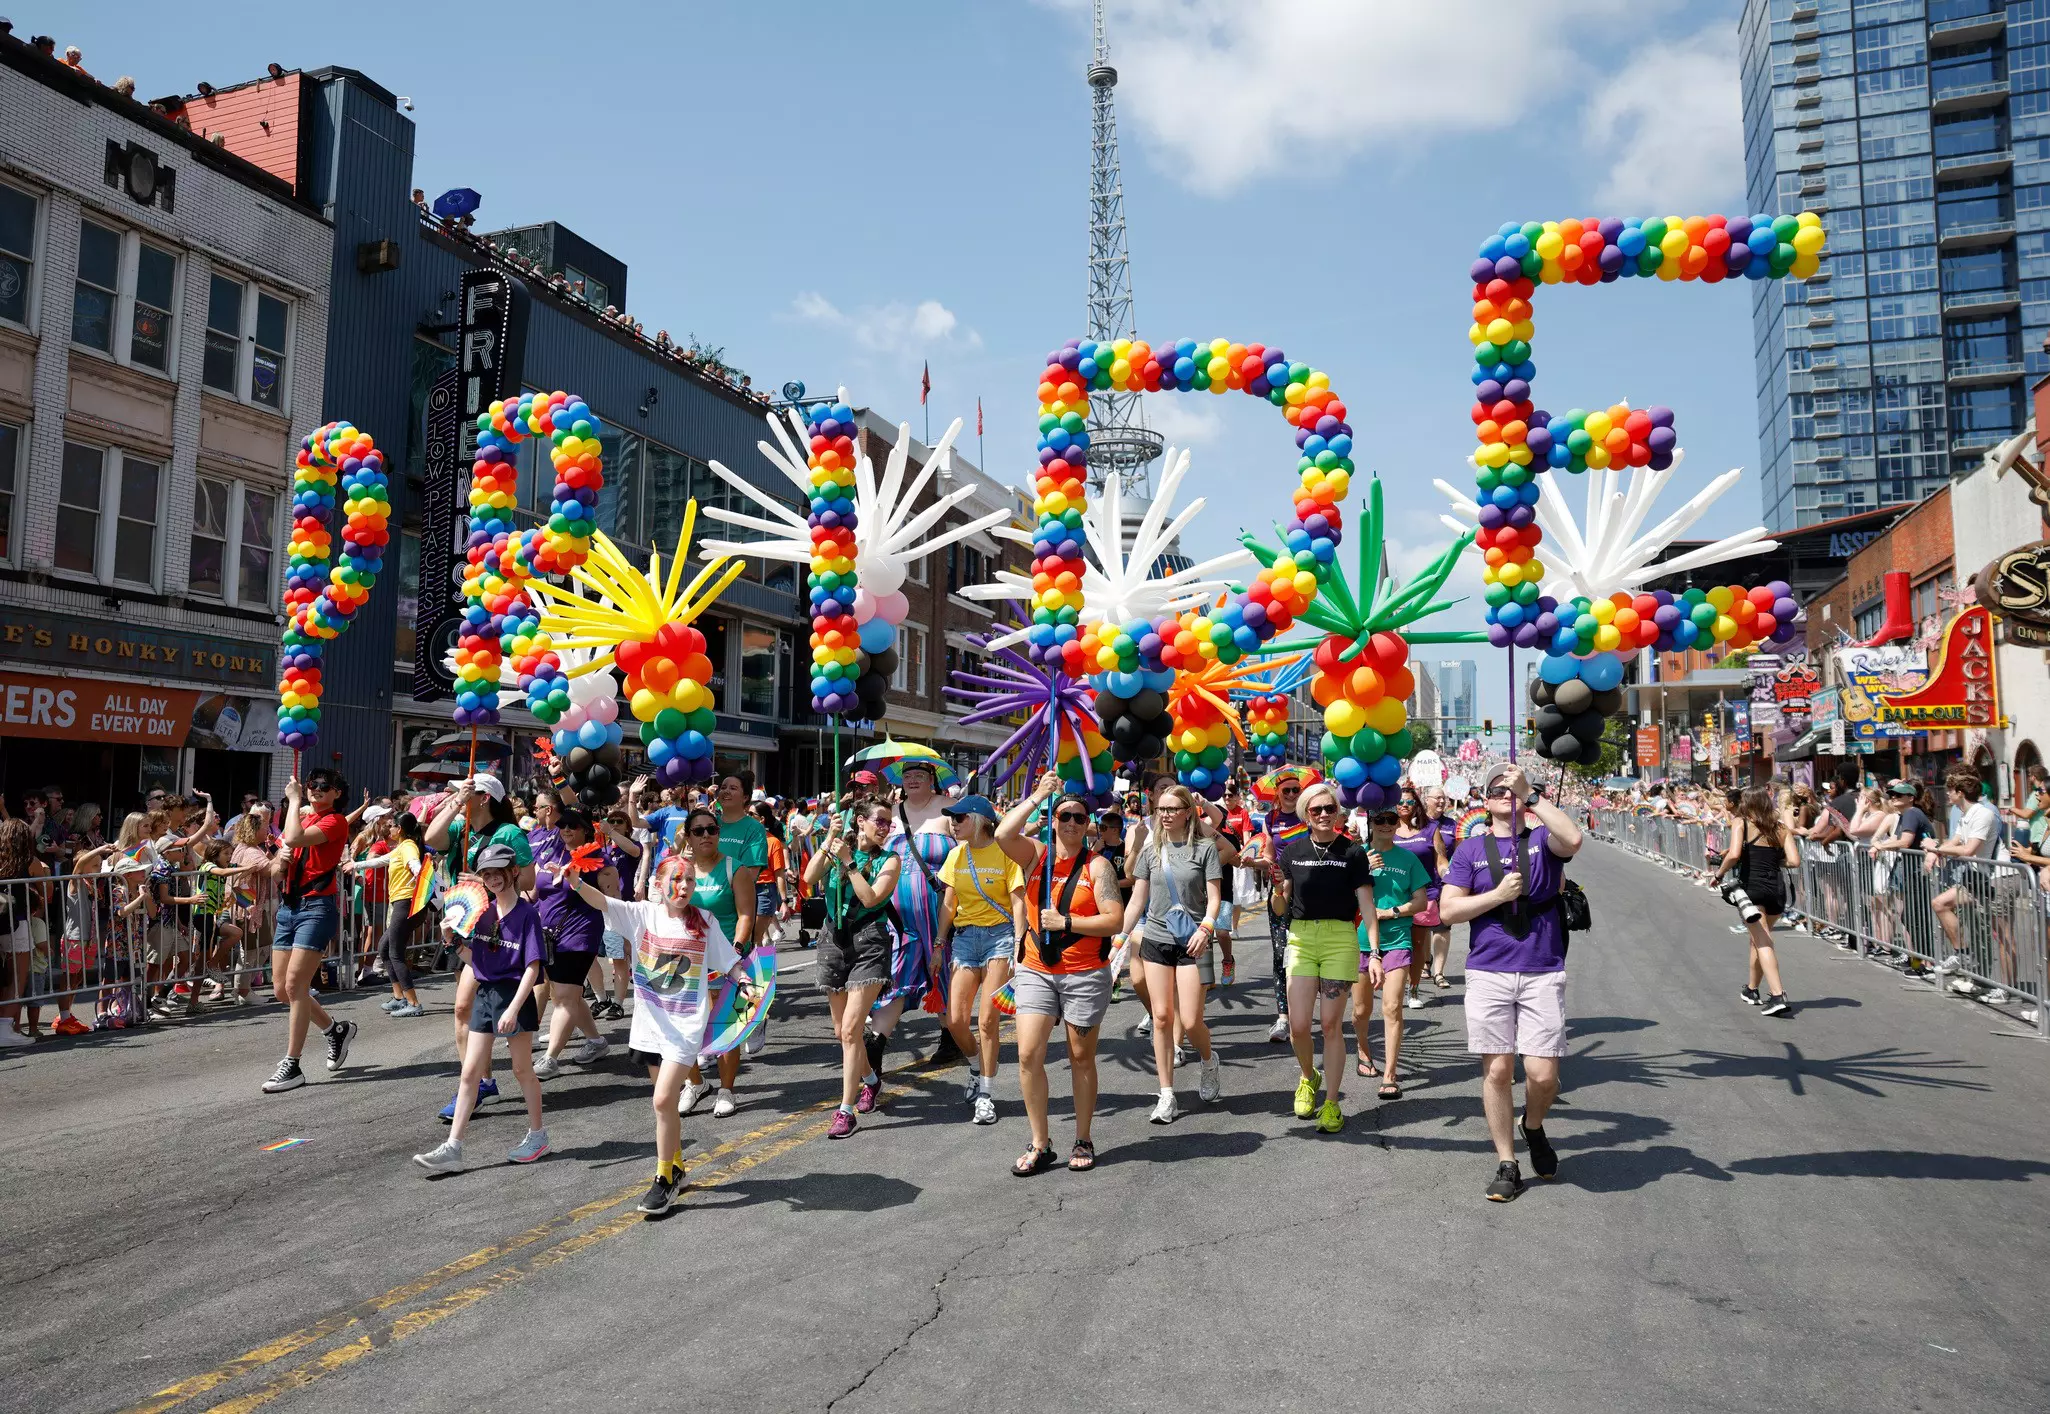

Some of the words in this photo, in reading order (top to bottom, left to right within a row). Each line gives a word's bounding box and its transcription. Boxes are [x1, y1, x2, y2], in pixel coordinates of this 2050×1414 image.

[435, 392, 445, 407] IN
[424, 490, 440, 610] PLACES
[1829, 531, 1880, 557] ASSE
[2018, 626, 2037, 641] ON
[68, 632, 179, 663] HONKY
[192, 650, 263, 673] TONK
[1960, 616, 1993, 724] JACKS
[0, 684, 77, 728] ERS
[104, 694, 135, 713] ALL
[139, 697, 168, 716] DAY
[91, 713, 144, 733] EVERY
[147, 719, 176, 736] DAY
